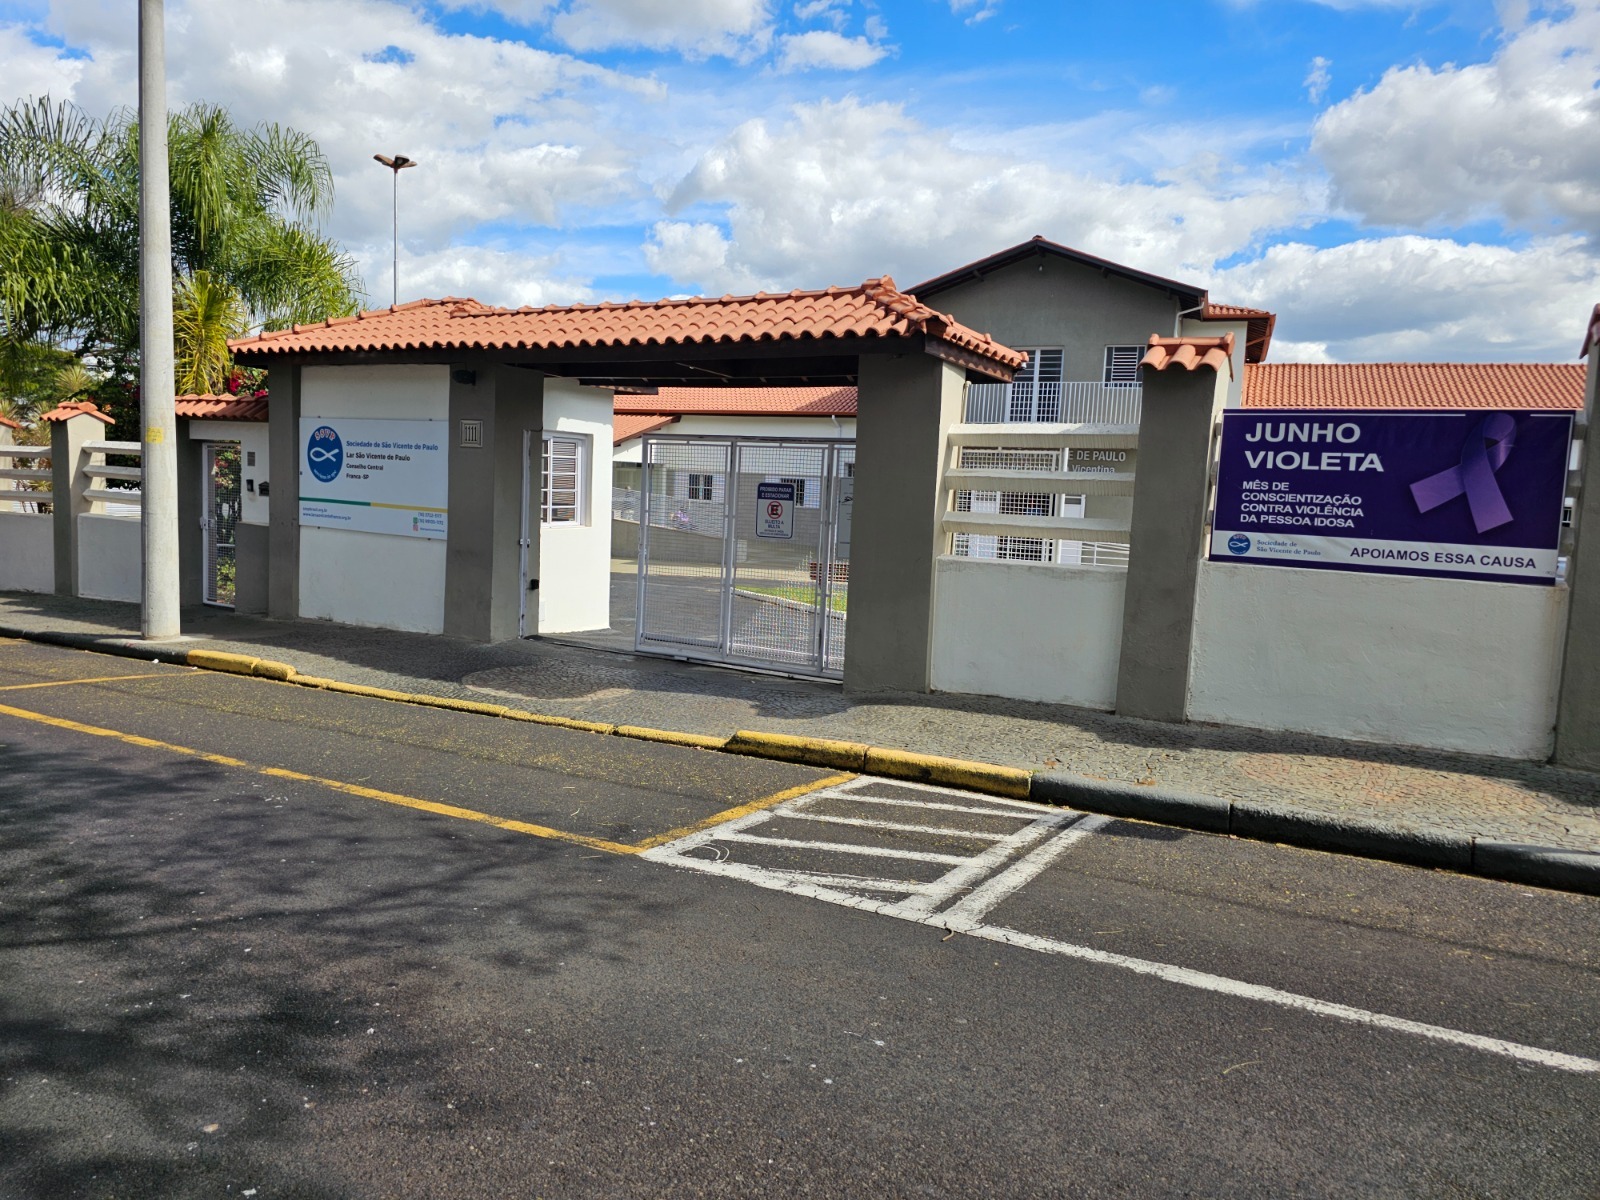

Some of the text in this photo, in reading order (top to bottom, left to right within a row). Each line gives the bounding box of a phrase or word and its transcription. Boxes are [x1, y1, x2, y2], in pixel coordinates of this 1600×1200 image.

[464, 425, 477, 442] 1111
[1245, 422, 1361, 443] JUNHO
[366, 452, 386, 460] Vicente
[1076, 451, 1090, 461] DE
[1092, 451, 1126, 462] PAULO
[1244, 450, 1385, 472] VIOLETA
[1072, 465, 1115, 473] Vicentina
[1242, 479, 1289, 491] MÊS DE
[1241, 492, 1362, 506] CONSCIENTIZAÇÃO
[1240, 503, 1364, 517] CONTRA VIOLÊNCIA
[1240, 514, 1355, 528] DA PESSOA IDOSA
[1256, 539, 1288, 547] Sociedade
[1269, 547, 1293, 555] Vicente
[1350, 548, 1537, 569] APOIAMOS ESSA CAUSA
